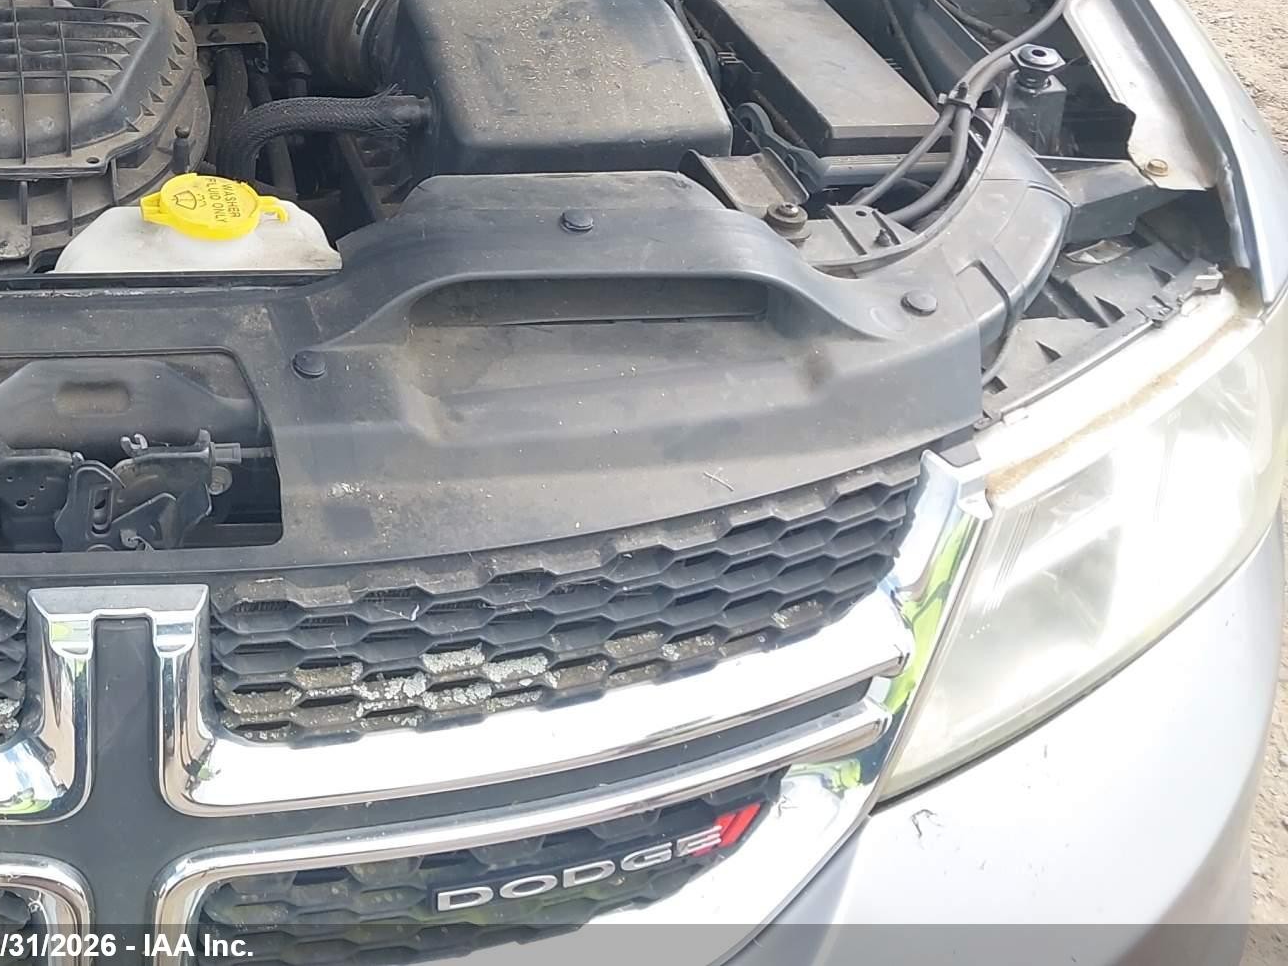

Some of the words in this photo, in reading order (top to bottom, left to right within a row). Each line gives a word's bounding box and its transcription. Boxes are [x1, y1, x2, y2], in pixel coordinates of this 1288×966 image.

[206, 177, 221, 200] FLUID
[222, 183, 241, 218] WASHER
[212, 202, 229, 222] ONLY
[437, 824, 722, 912] DODGE
